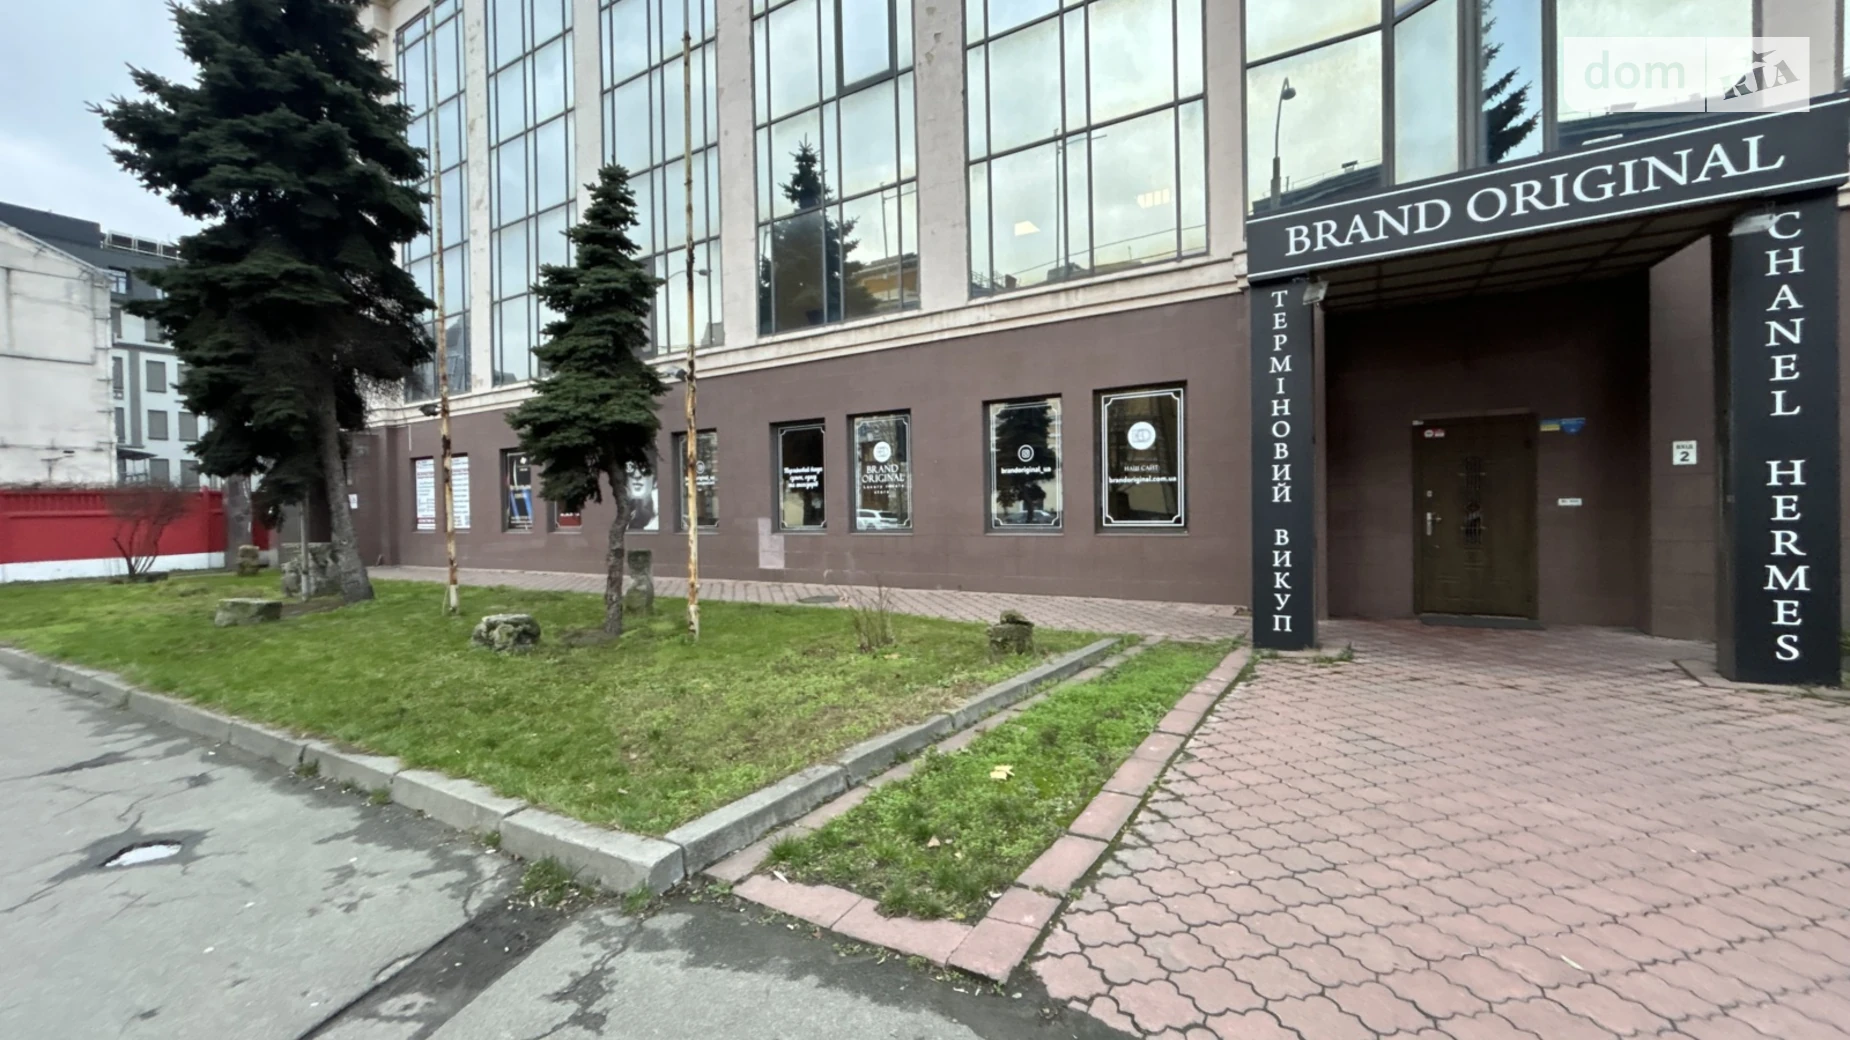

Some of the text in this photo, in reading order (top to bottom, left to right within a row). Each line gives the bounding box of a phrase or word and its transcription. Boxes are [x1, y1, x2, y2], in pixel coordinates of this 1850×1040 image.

[1284, 134, 1786, 257] BRAND ORIGINAL
[1763, 211, 1811, 661] CHANEL HERMES
[1269, 289, 1293, 633] ТЕРМІНОВИЙ ВИКУП
[1680, 451, 1690, 462] 2
[866, 464, 899, 474] BRAND
[1000, 466, 1052, 475] brandoriginal_ua
[861, 473, 905, 483] ORIGINAL
[1108, 475, 1177, 484] brandoriginal.com.ua
